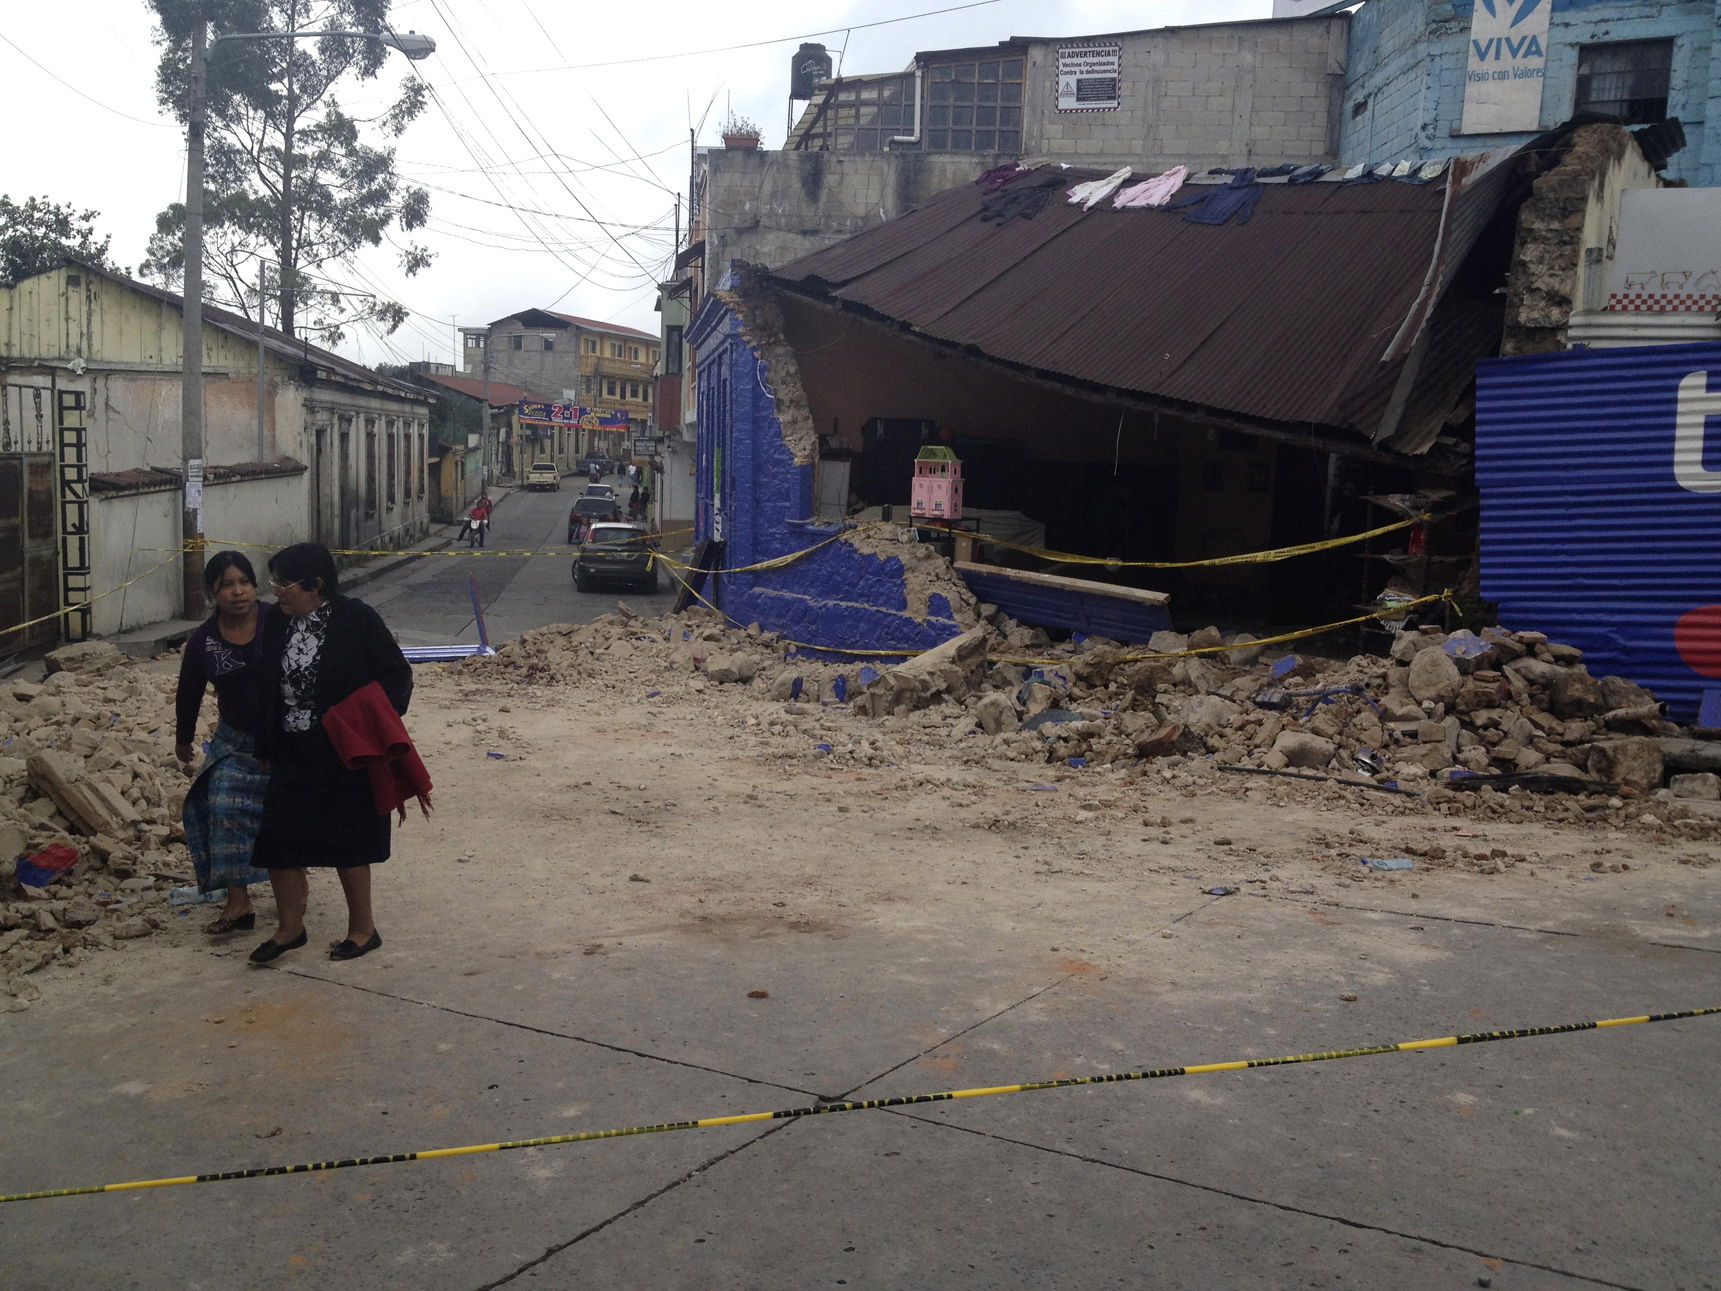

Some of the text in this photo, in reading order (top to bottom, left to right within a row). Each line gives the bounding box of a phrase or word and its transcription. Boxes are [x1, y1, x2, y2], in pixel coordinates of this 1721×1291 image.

[1472, 35, 1544, 62] VIVA
[1492, 70, 1510, 81] con
[1512, 66, 1545, 79] Valores
[58, 389, 92, 642] PARQUEO
